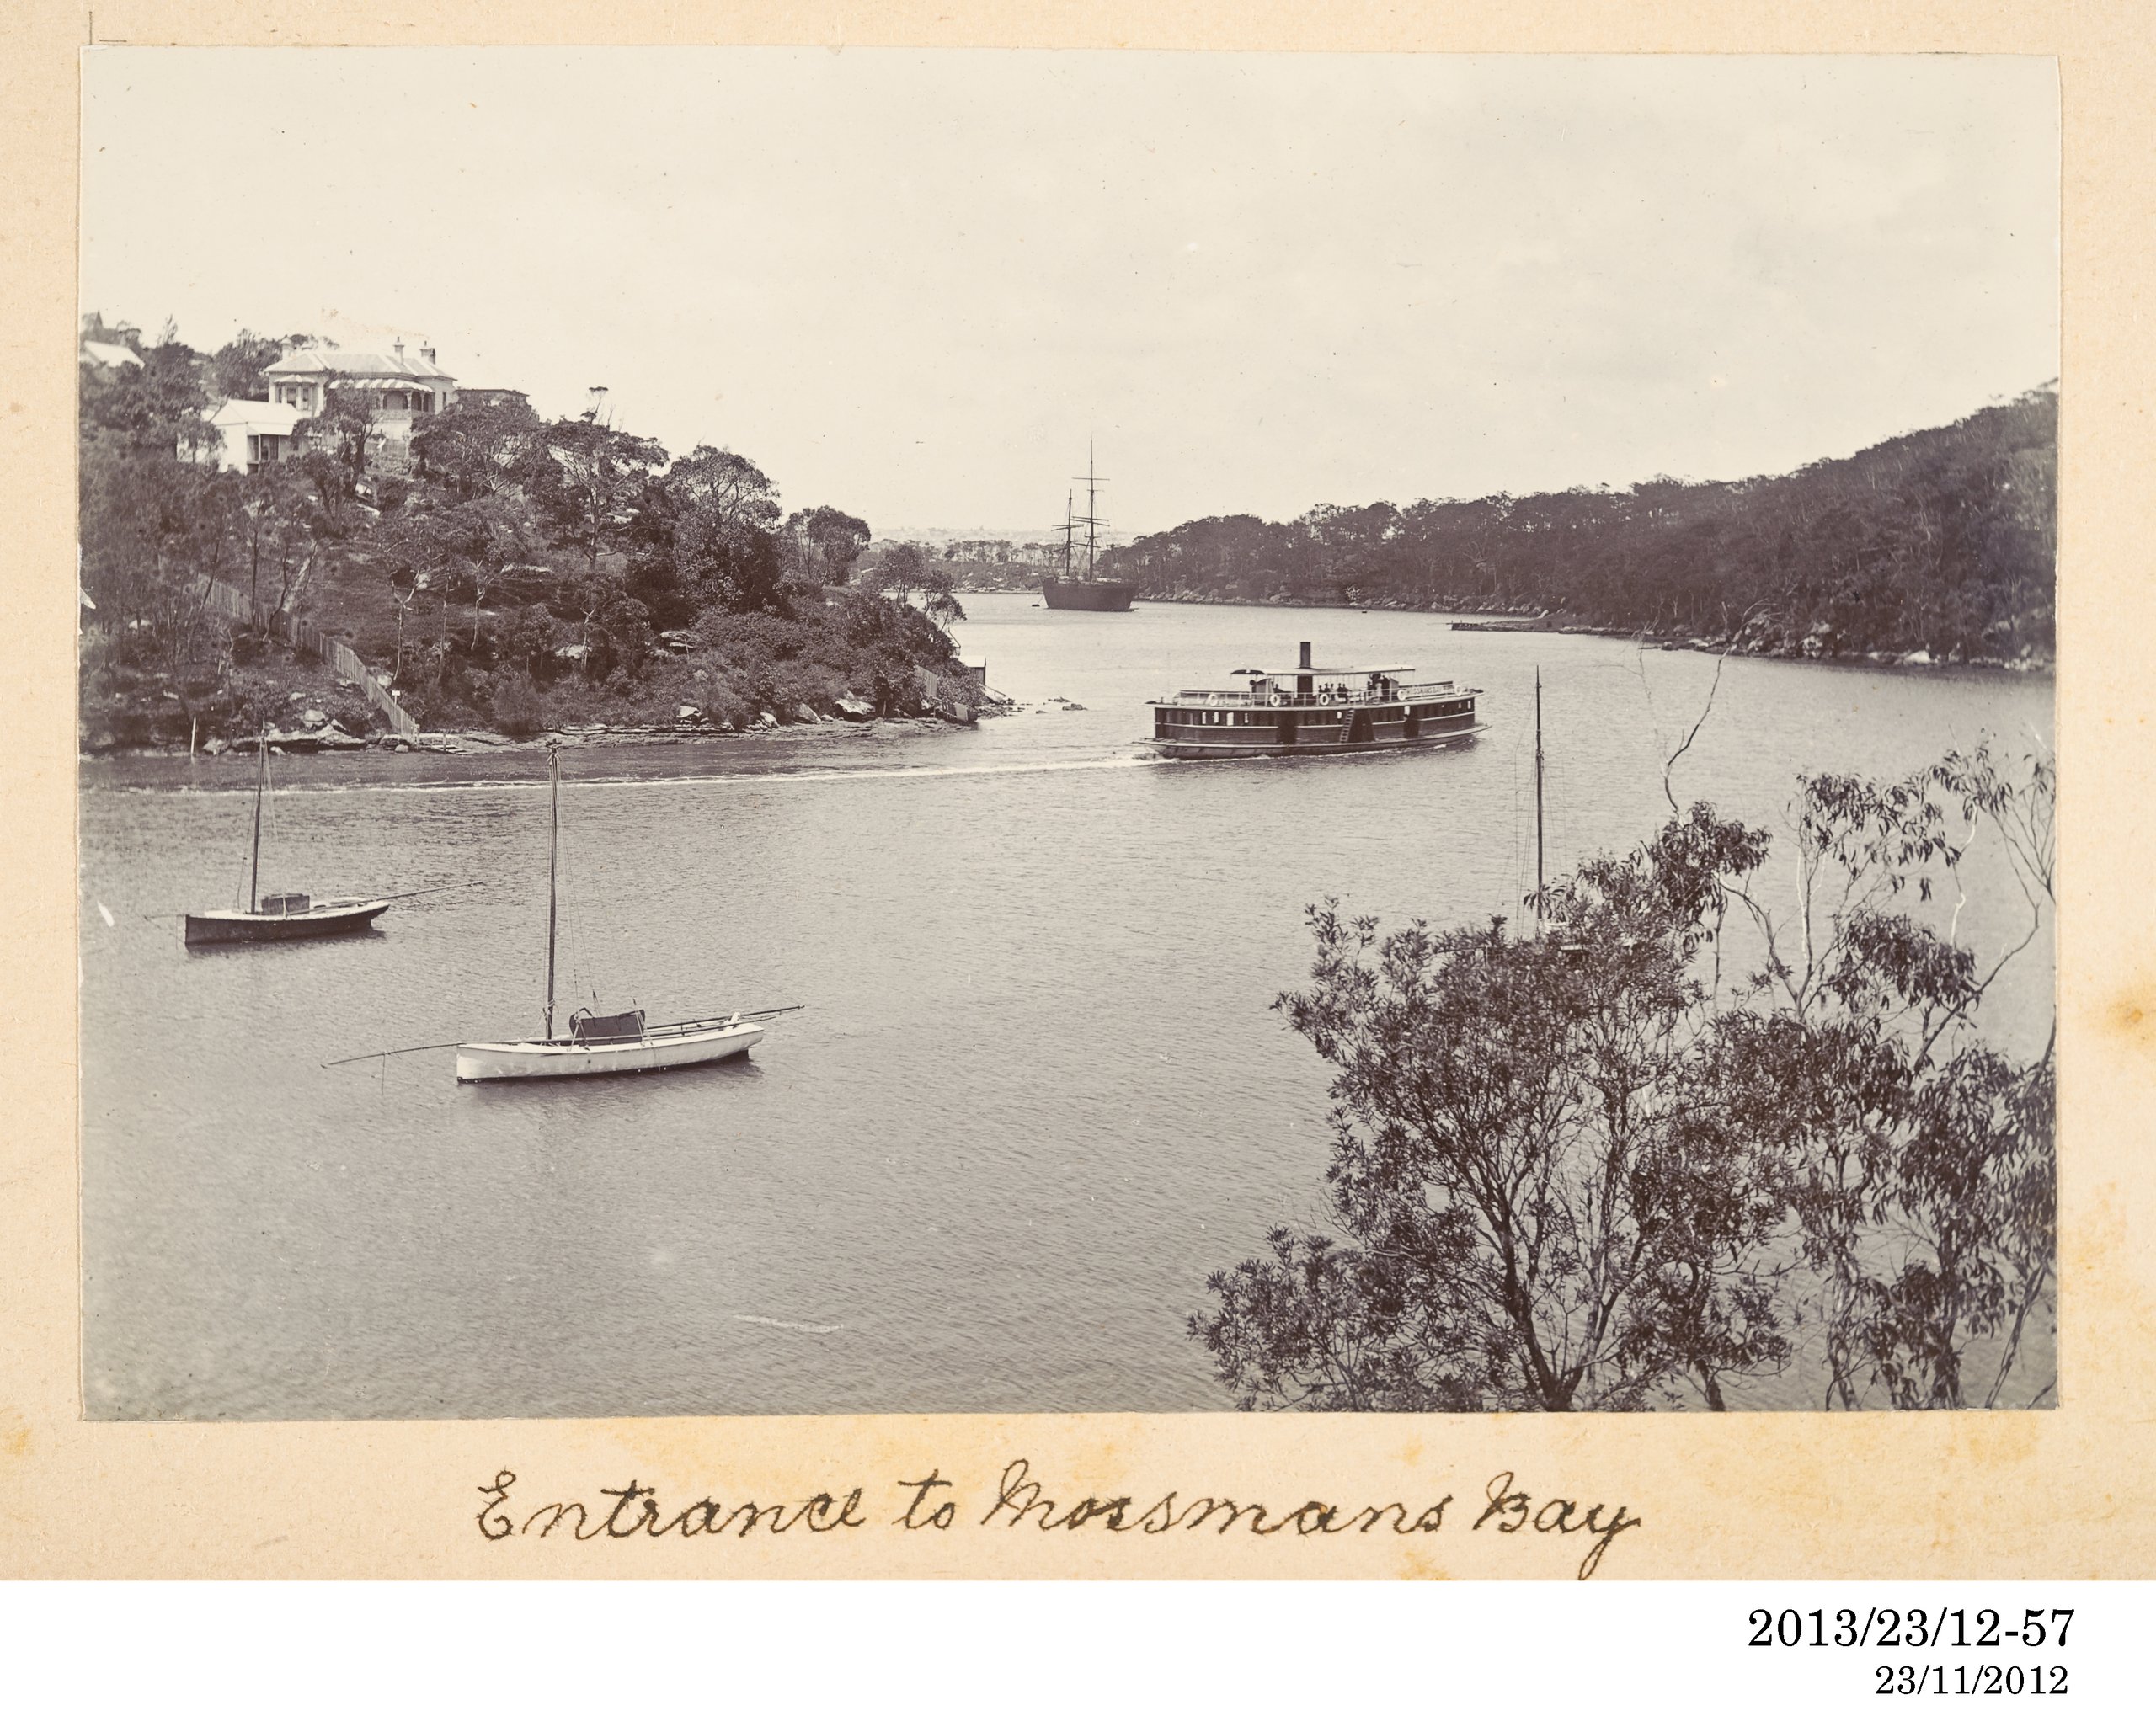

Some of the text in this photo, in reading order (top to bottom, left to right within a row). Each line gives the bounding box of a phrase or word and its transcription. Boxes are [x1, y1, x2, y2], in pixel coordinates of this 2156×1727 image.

[477, 1458, 1641, 1579] Entrance to Mossmans Bay
